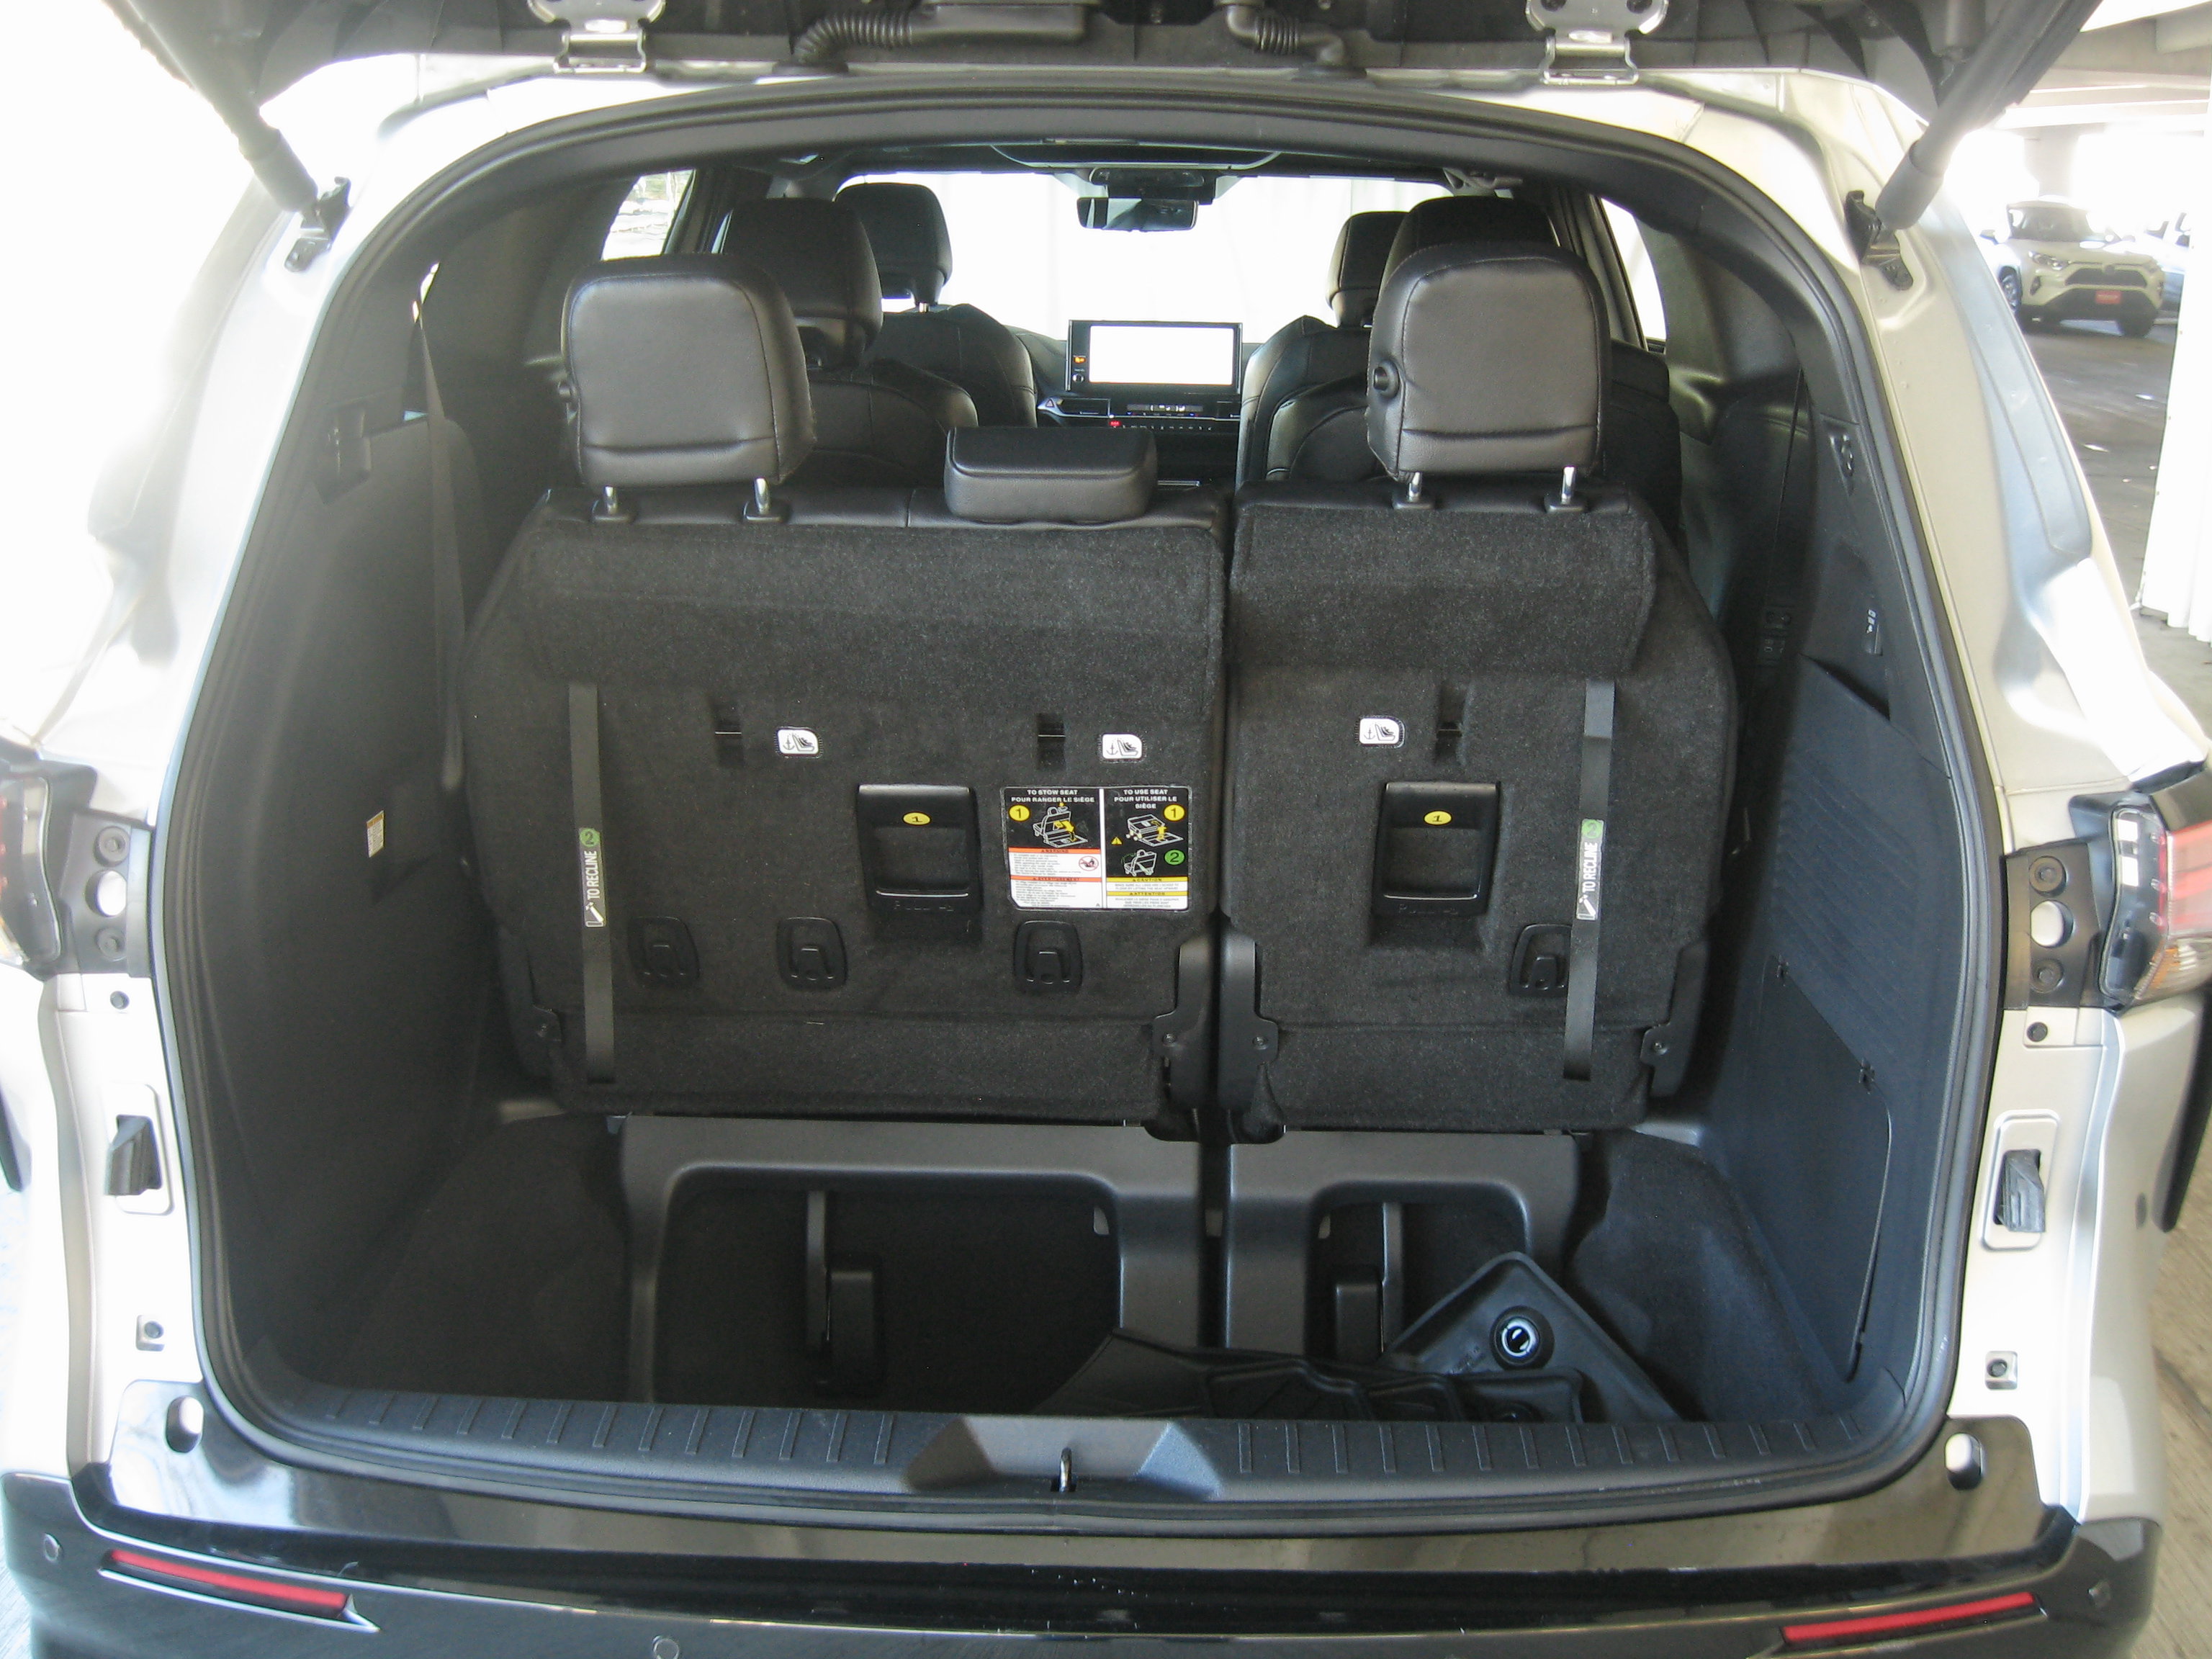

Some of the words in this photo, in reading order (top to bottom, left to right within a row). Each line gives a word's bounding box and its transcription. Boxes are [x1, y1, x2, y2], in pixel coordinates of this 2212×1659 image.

[1015, 808, 1022, 819] 1
[1170, 808, 1177, 818] 1
[1587, 822, 1597, 836] 2
[585, 831, 595, 845] 2
[1169, 852, 1179, 863] 2
[1583, 842, 1598, 880] RECLINE
[584, 850, 600, 887] RECLINE
[1582, 881, 1596, 893] TO
[587, 889, 601, 900] TO
